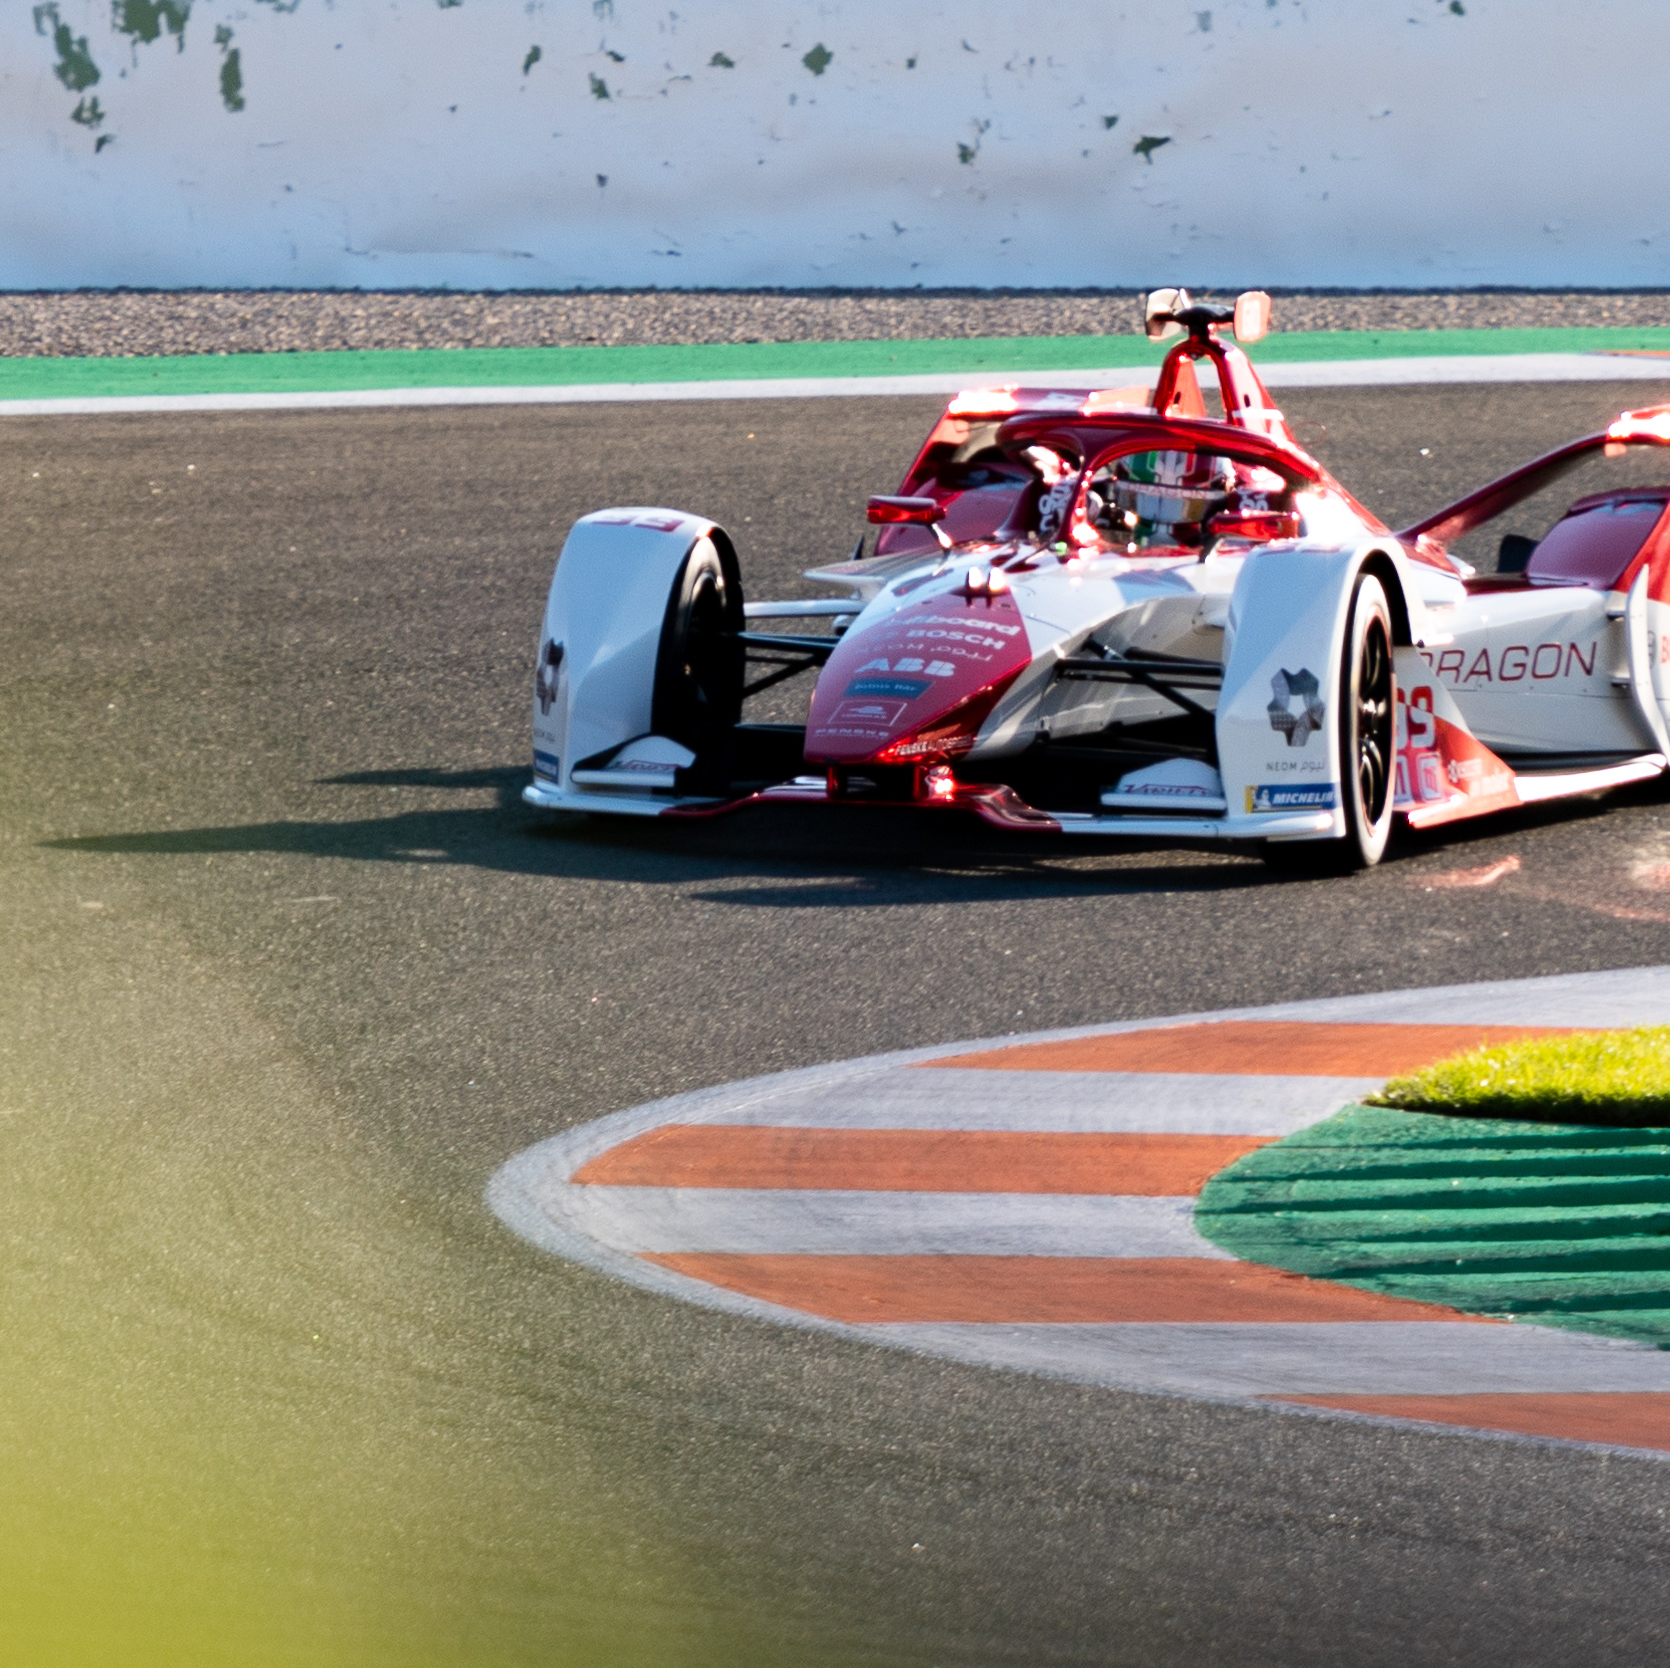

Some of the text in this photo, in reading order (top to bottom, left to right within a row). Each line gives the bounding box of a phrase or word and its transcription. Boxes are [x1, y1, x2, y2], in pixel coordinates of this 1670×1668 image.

[905, 628, 1006, 650] BOSCH
[854, 657, 957, 677] ABB
[1266, 762, 1297, 772] NEOM
[1272, 790, 1336, 804] MICHELIN
